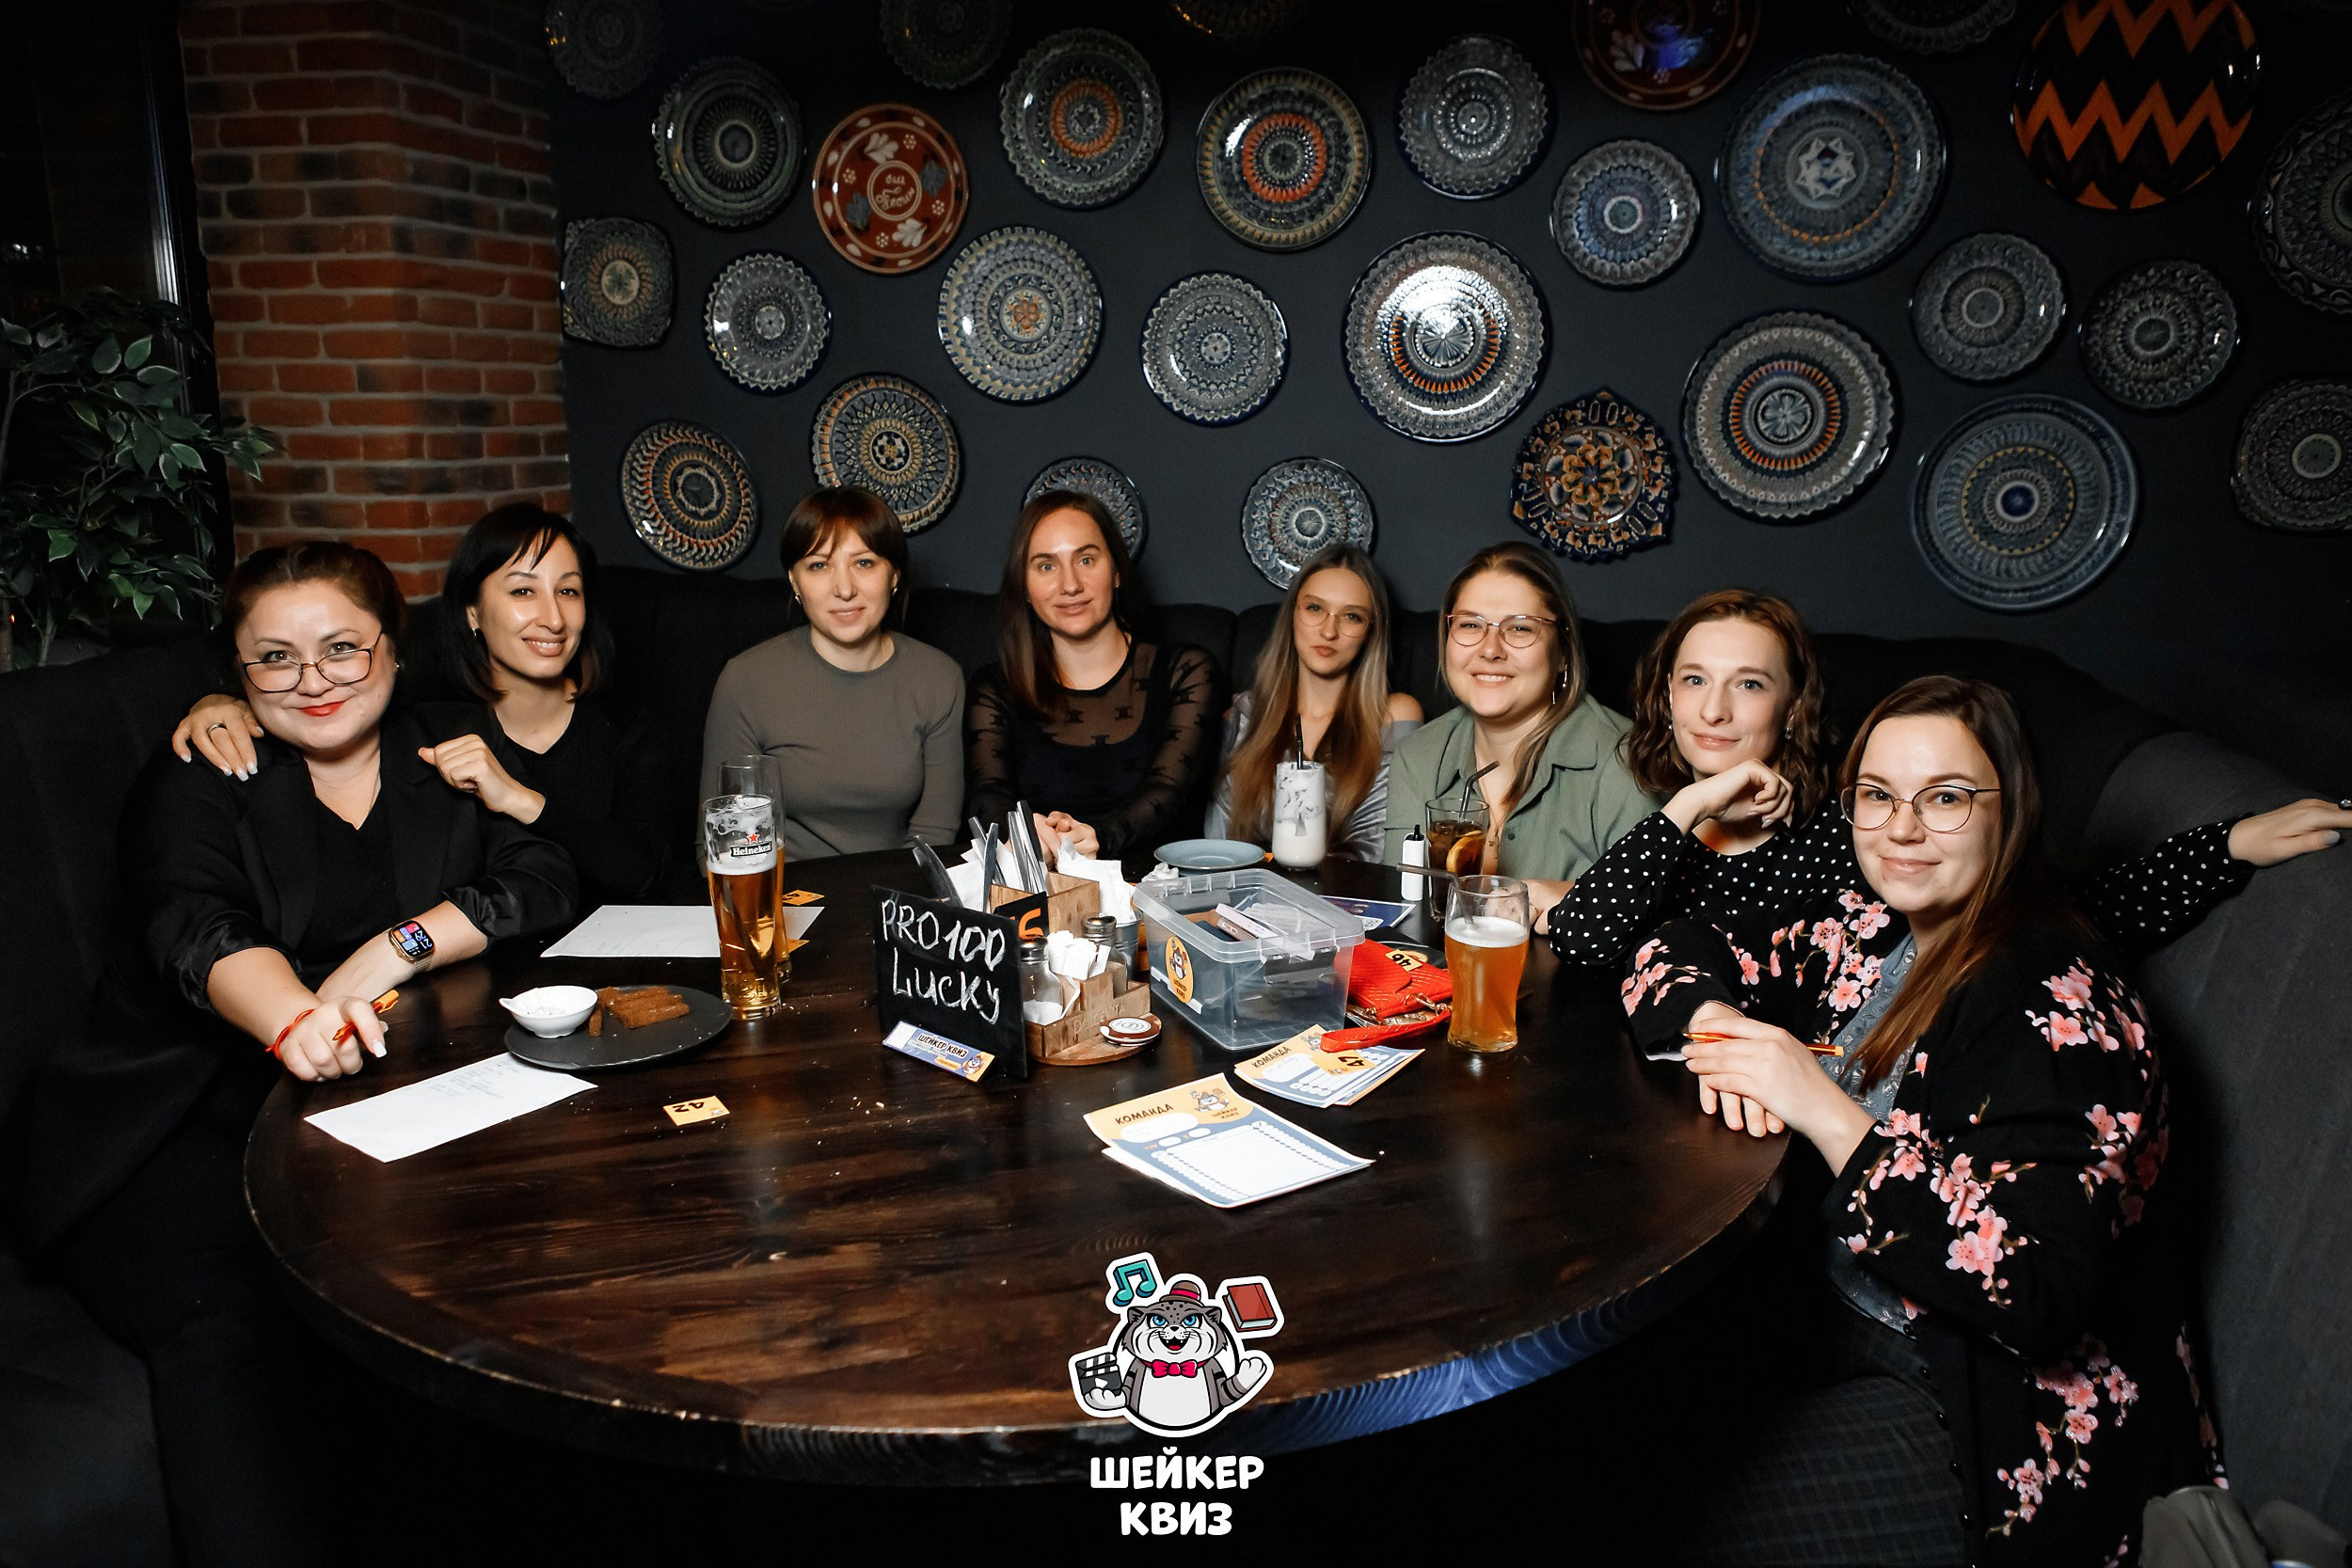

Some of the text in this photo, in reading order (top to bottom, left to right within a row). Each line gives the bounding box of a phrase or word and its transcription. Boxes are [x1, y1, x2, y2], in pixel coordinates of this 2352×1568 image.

[732, 845, 771, 856] Heineken
[1391, 954, 1412, 967] 46
[917, 1034, 947, 1050] ШЕЙКЕР
[946, 1044, 968, 1058] КВИЗ
[1251, 1046, 1292, 1069] КОМАНДА
[1337, 1055, 1365, 1067] 47
[672, 1101, 705, 1113] 42
[1115, 1103, 1174, 1125] КОМАНДА
